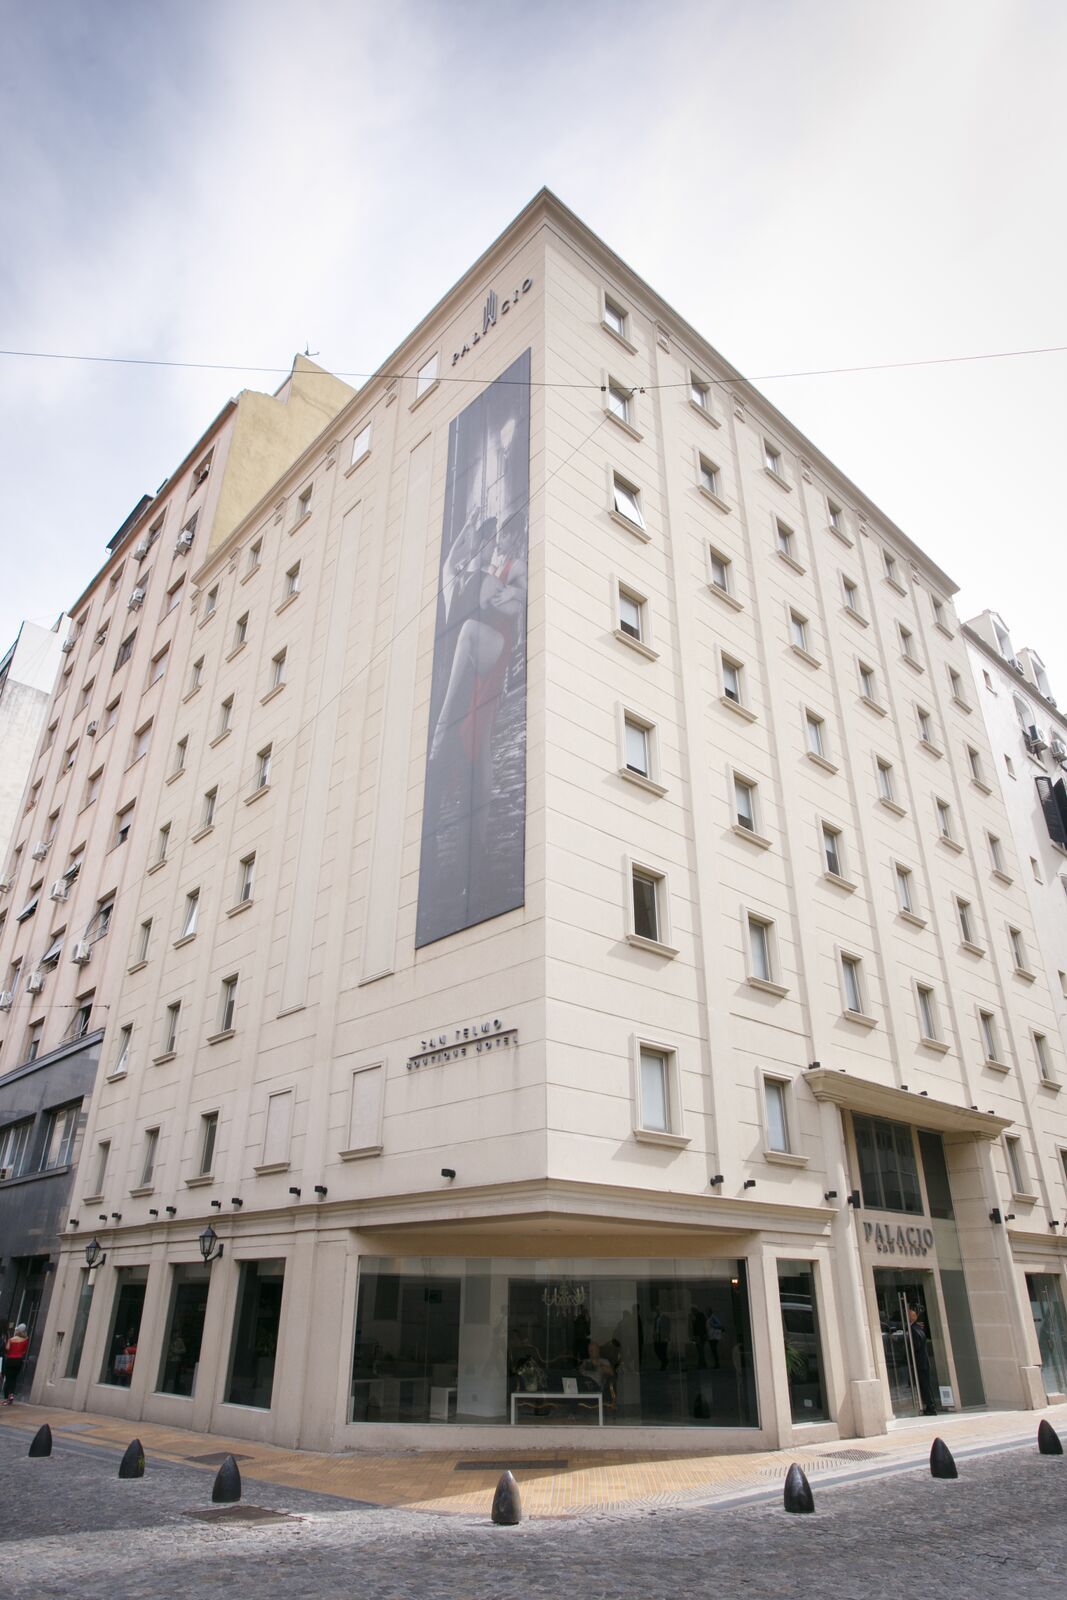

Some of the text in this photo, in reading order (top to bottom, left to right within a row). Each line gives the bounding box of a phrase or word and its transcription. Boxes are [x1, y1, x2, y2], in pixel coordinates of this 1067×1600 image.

[452, 278, 533, 366] PALACIO
[421, 1019, 502, 1051] SAN TELMO
[406, 1035, 518, 1071] BOUTIQUE HOTEL
[863, 1222, 934, 1248] PALACIO
